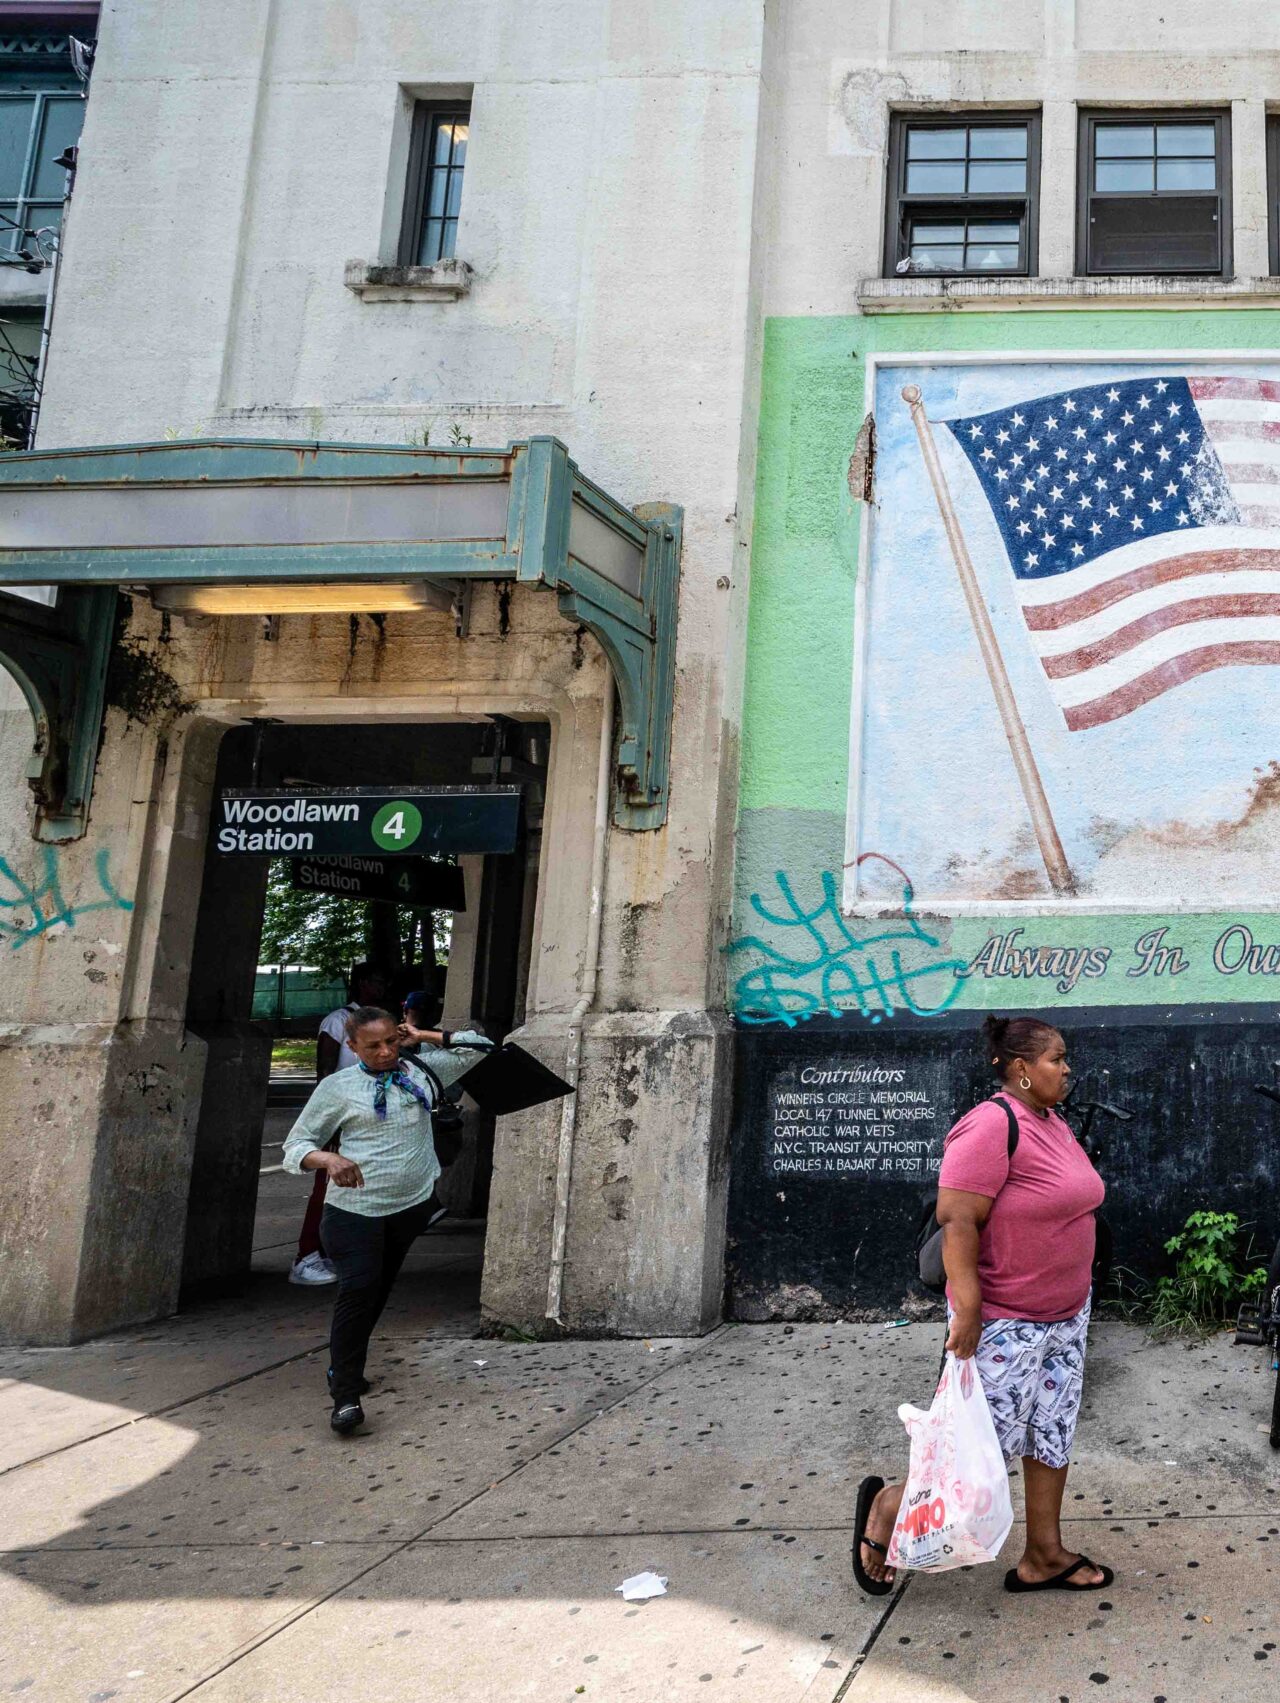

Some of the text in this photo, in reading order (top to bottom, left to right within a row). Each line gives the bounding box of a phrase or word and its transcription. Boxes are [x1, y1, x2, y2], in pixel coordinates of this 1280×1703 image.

[222, 799, 360, 823] Woodlawn
[382, 811, 406, 840] 4
[217, 827, 314, 852] Station
[299, 866, 361, 892] Station
[398, 872, 411, 893] 4
[955, 927, 1112, 994] Always
[1125, 926, 1189, 978] In
[800, 1064, 906, 1085] Contributors
[776, 1092, 824, 1105] WINNERS
[870, 1091, 930, 1104] MEMORIAL
[774, 1107, 936, 1122] LOCAL 147 TUNNEL WORKERS
[774, 1124, 895, 1138] CATHOLIC WAR VETS
[808, 1141, 861, 1154] TRANSIT
[864, 1140, 933, 1154] AUTHORITY
[773, 1159, 821, 1172] CHARLES
[879, 1158, 893, 1171] JR
[896, 1158, 921, 1171] POST
